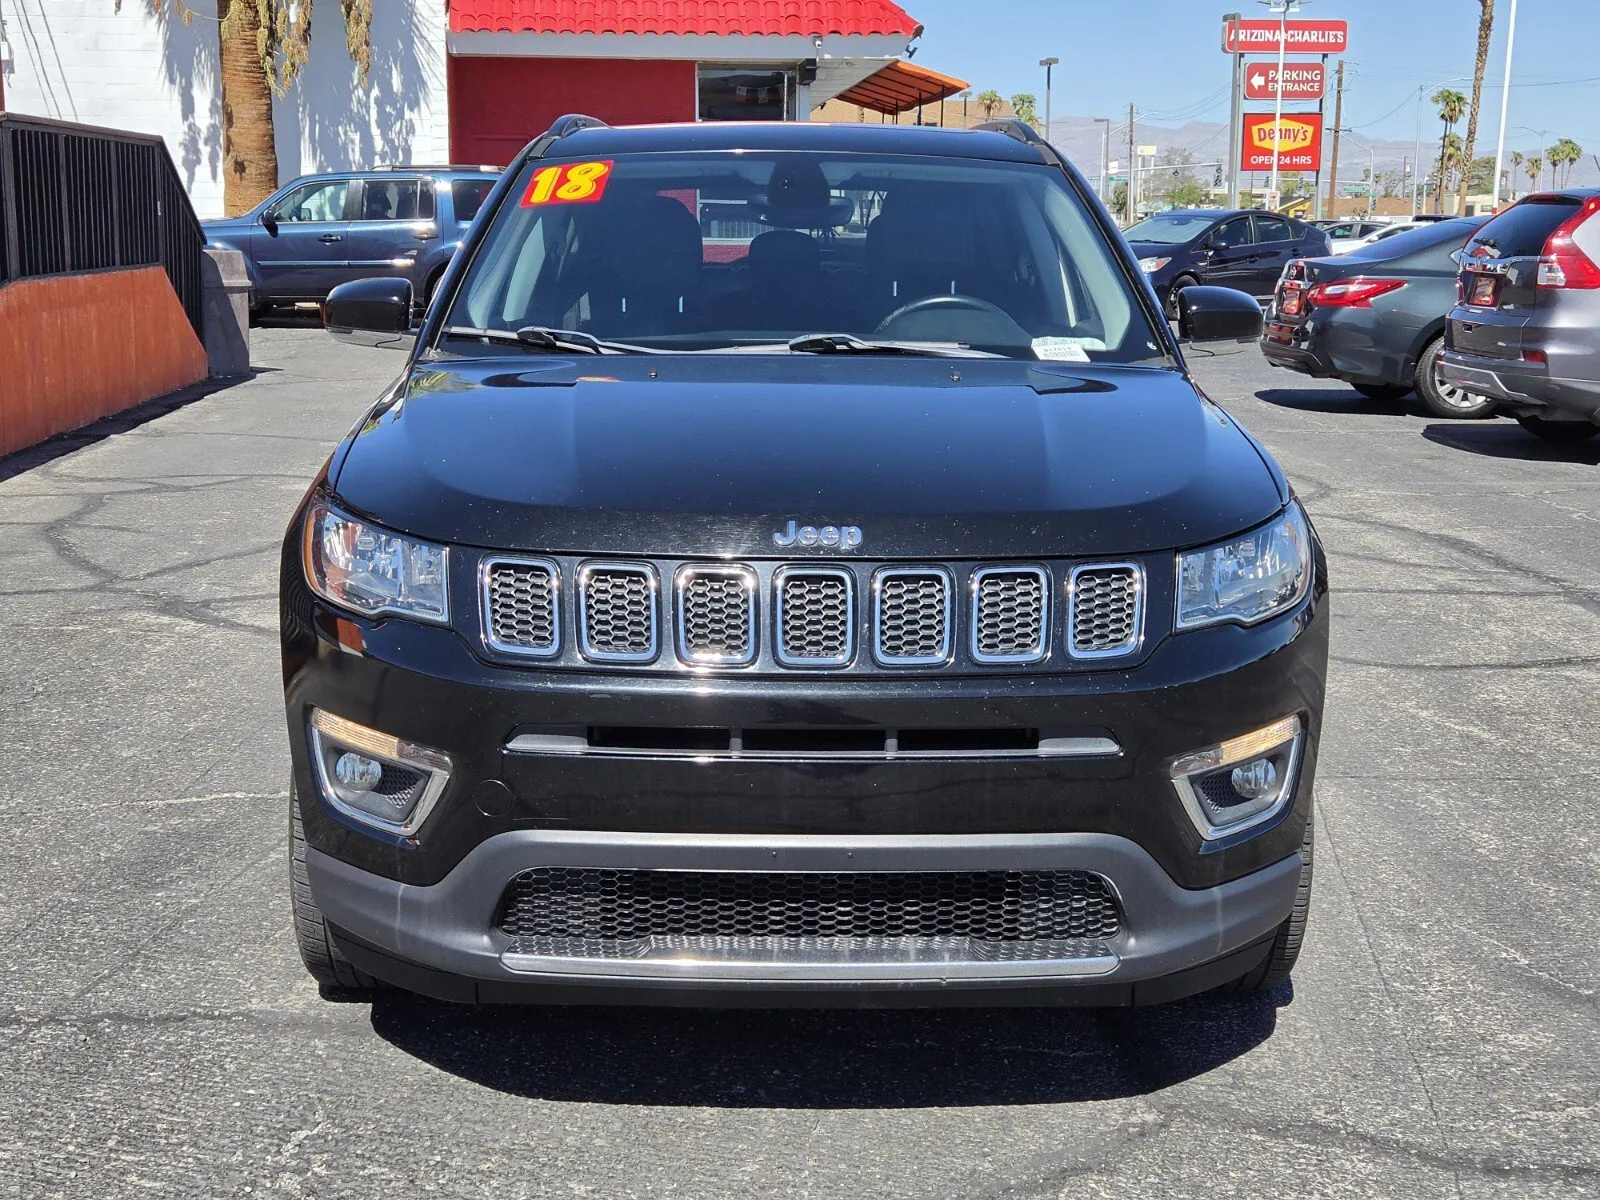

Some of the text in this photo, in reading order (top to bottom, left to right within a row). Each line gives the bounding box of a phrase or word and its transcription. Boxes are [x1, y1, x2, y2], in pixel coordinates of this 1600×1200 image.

[1287, 31, 1344, 43] CHARLIE'S
[1268, 82, 1320, 92] ENTRANCE
[1250, 155, 1312, 165] OPEN 24 HRS
[530, 162, 609, 203] 18
[773, 520, 863, 550] Jeep
